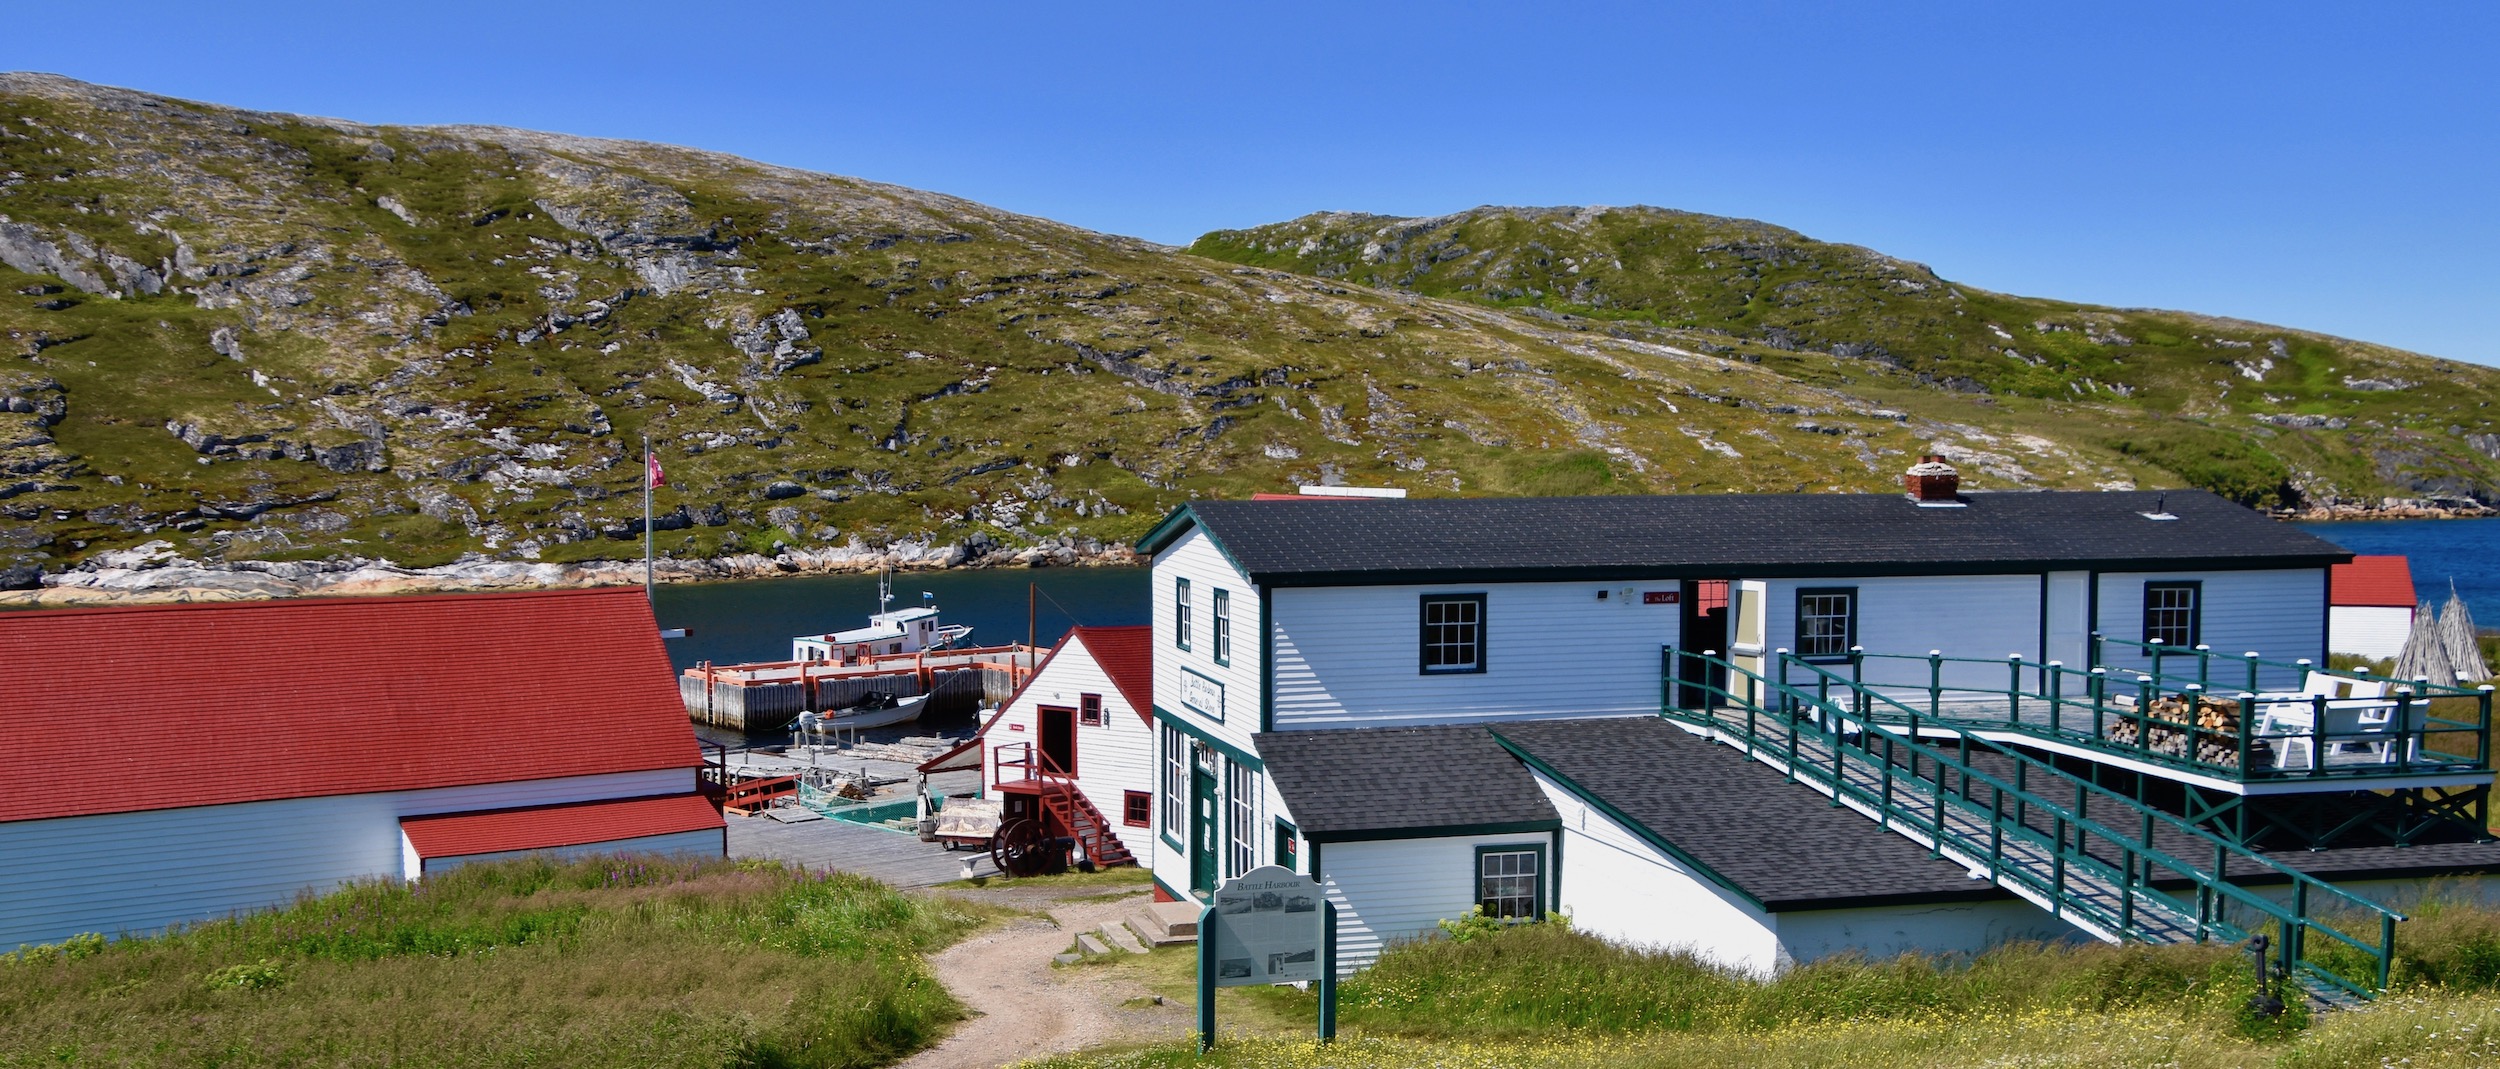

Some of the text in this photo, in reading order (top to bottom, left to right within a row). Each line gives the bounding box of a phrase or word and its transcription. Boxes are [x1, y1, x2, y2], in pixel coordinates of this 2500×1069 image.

[1661, 593, 1674, 602] Loft
[1237, 880, 1301, 891] BATTLE HARBOUR
